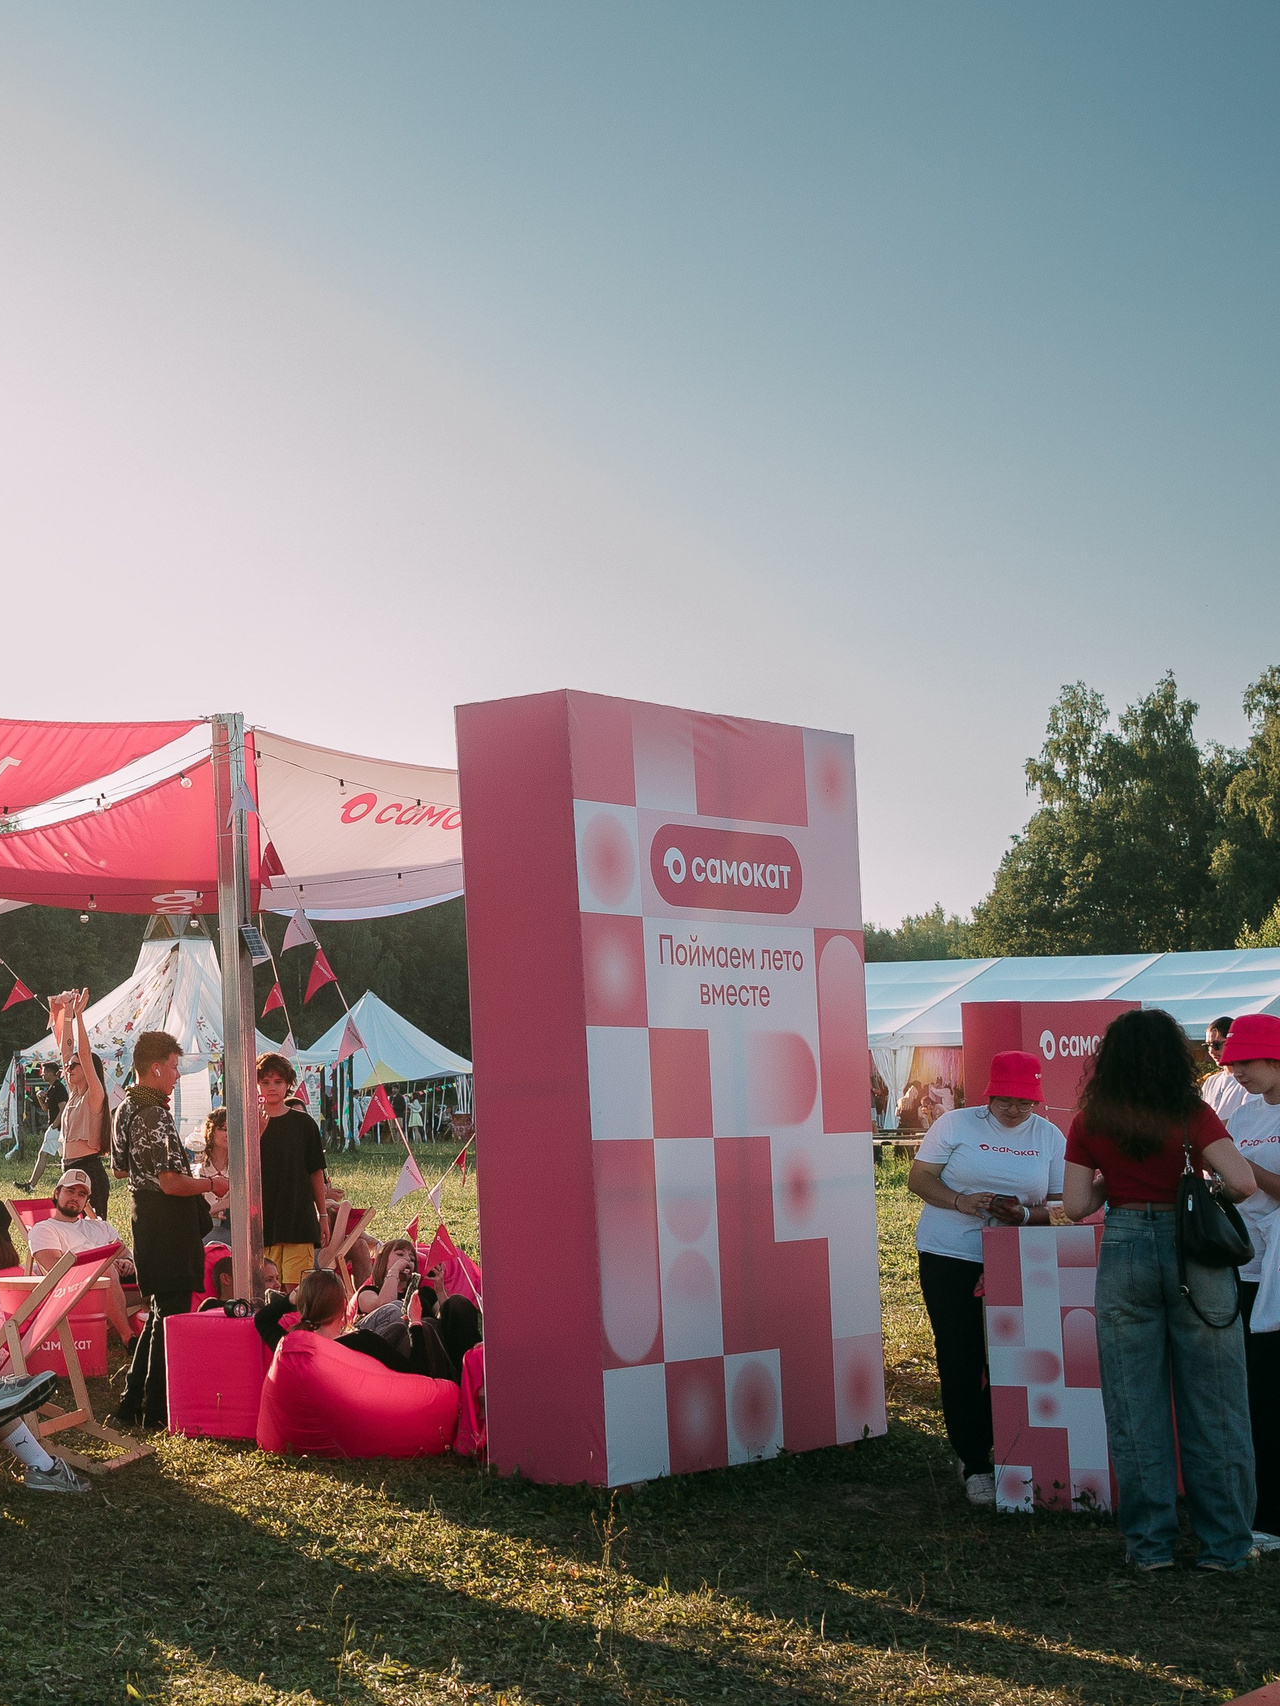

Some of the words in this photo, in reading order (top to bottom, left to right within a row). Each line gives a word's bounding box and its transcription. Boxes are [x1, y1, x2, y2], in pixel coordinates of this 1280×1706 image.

[375, 802, 461, 830] само
[691, 856, 791, 889] самокат
[658, 933, 755, 970] Поймаем
[760, 946, 804, 972] лето
[699, 983, 771, 1008] вместе
[1059, 1035, 1103, 1057] само
[37, 1340, 92, 1351] амкат
